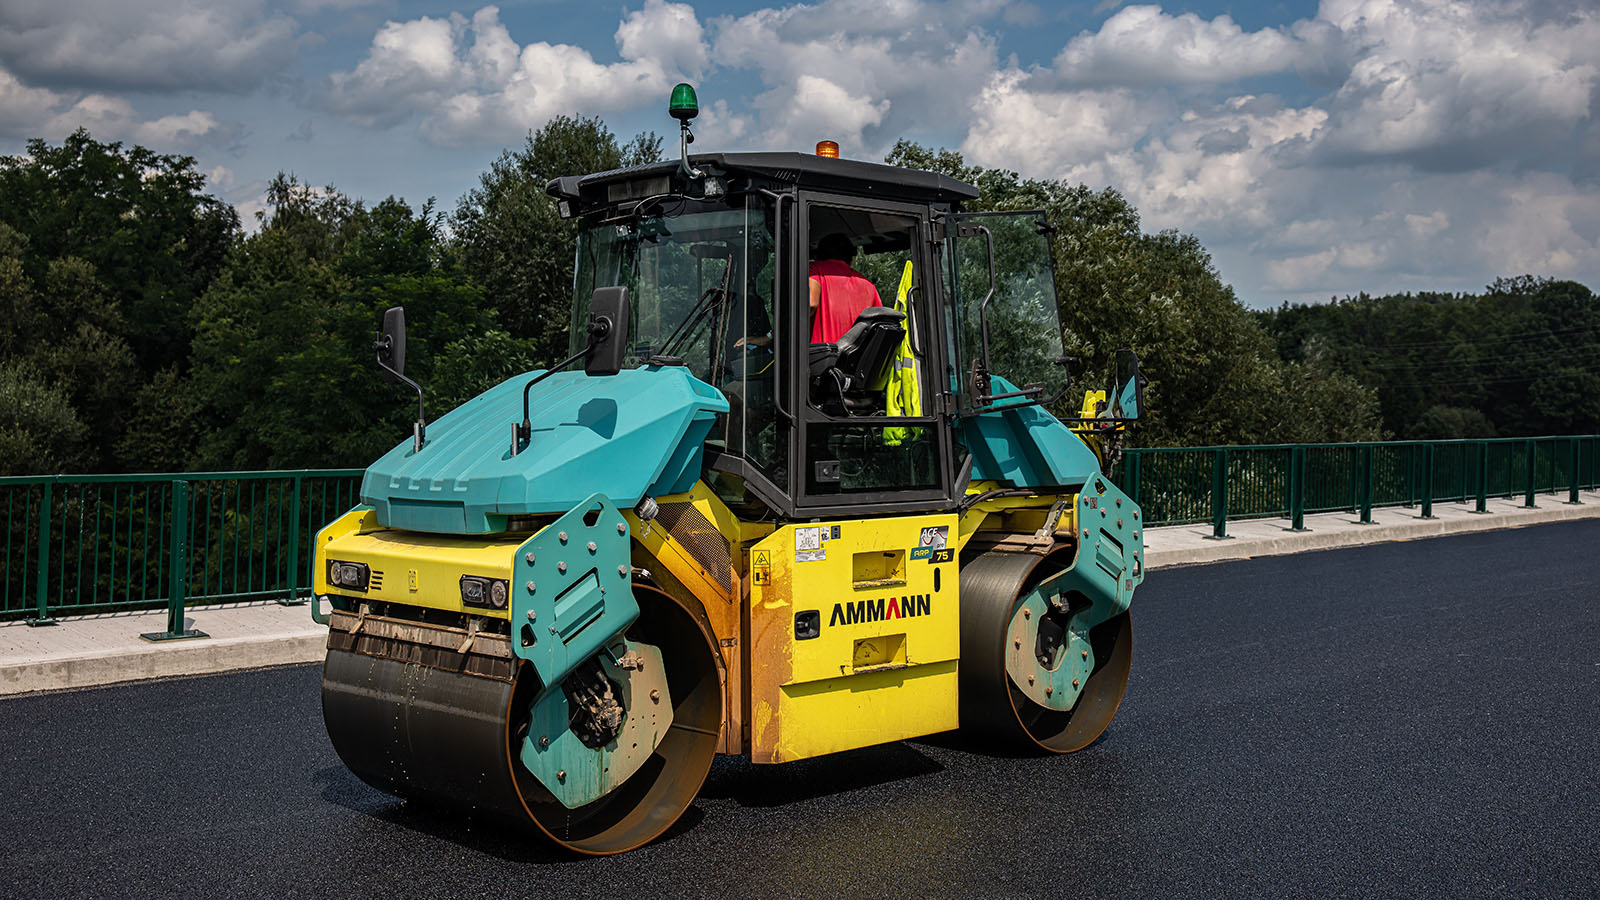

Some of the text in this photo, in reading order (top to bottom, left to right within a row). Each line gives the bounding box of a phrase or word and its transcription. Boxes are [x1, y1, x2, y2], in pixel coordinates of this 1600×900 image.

[921, 528, 938, 538] ACE
[914, 549, 949, 561] ARP 75
[829, 594, 931, 627] AMMANN
